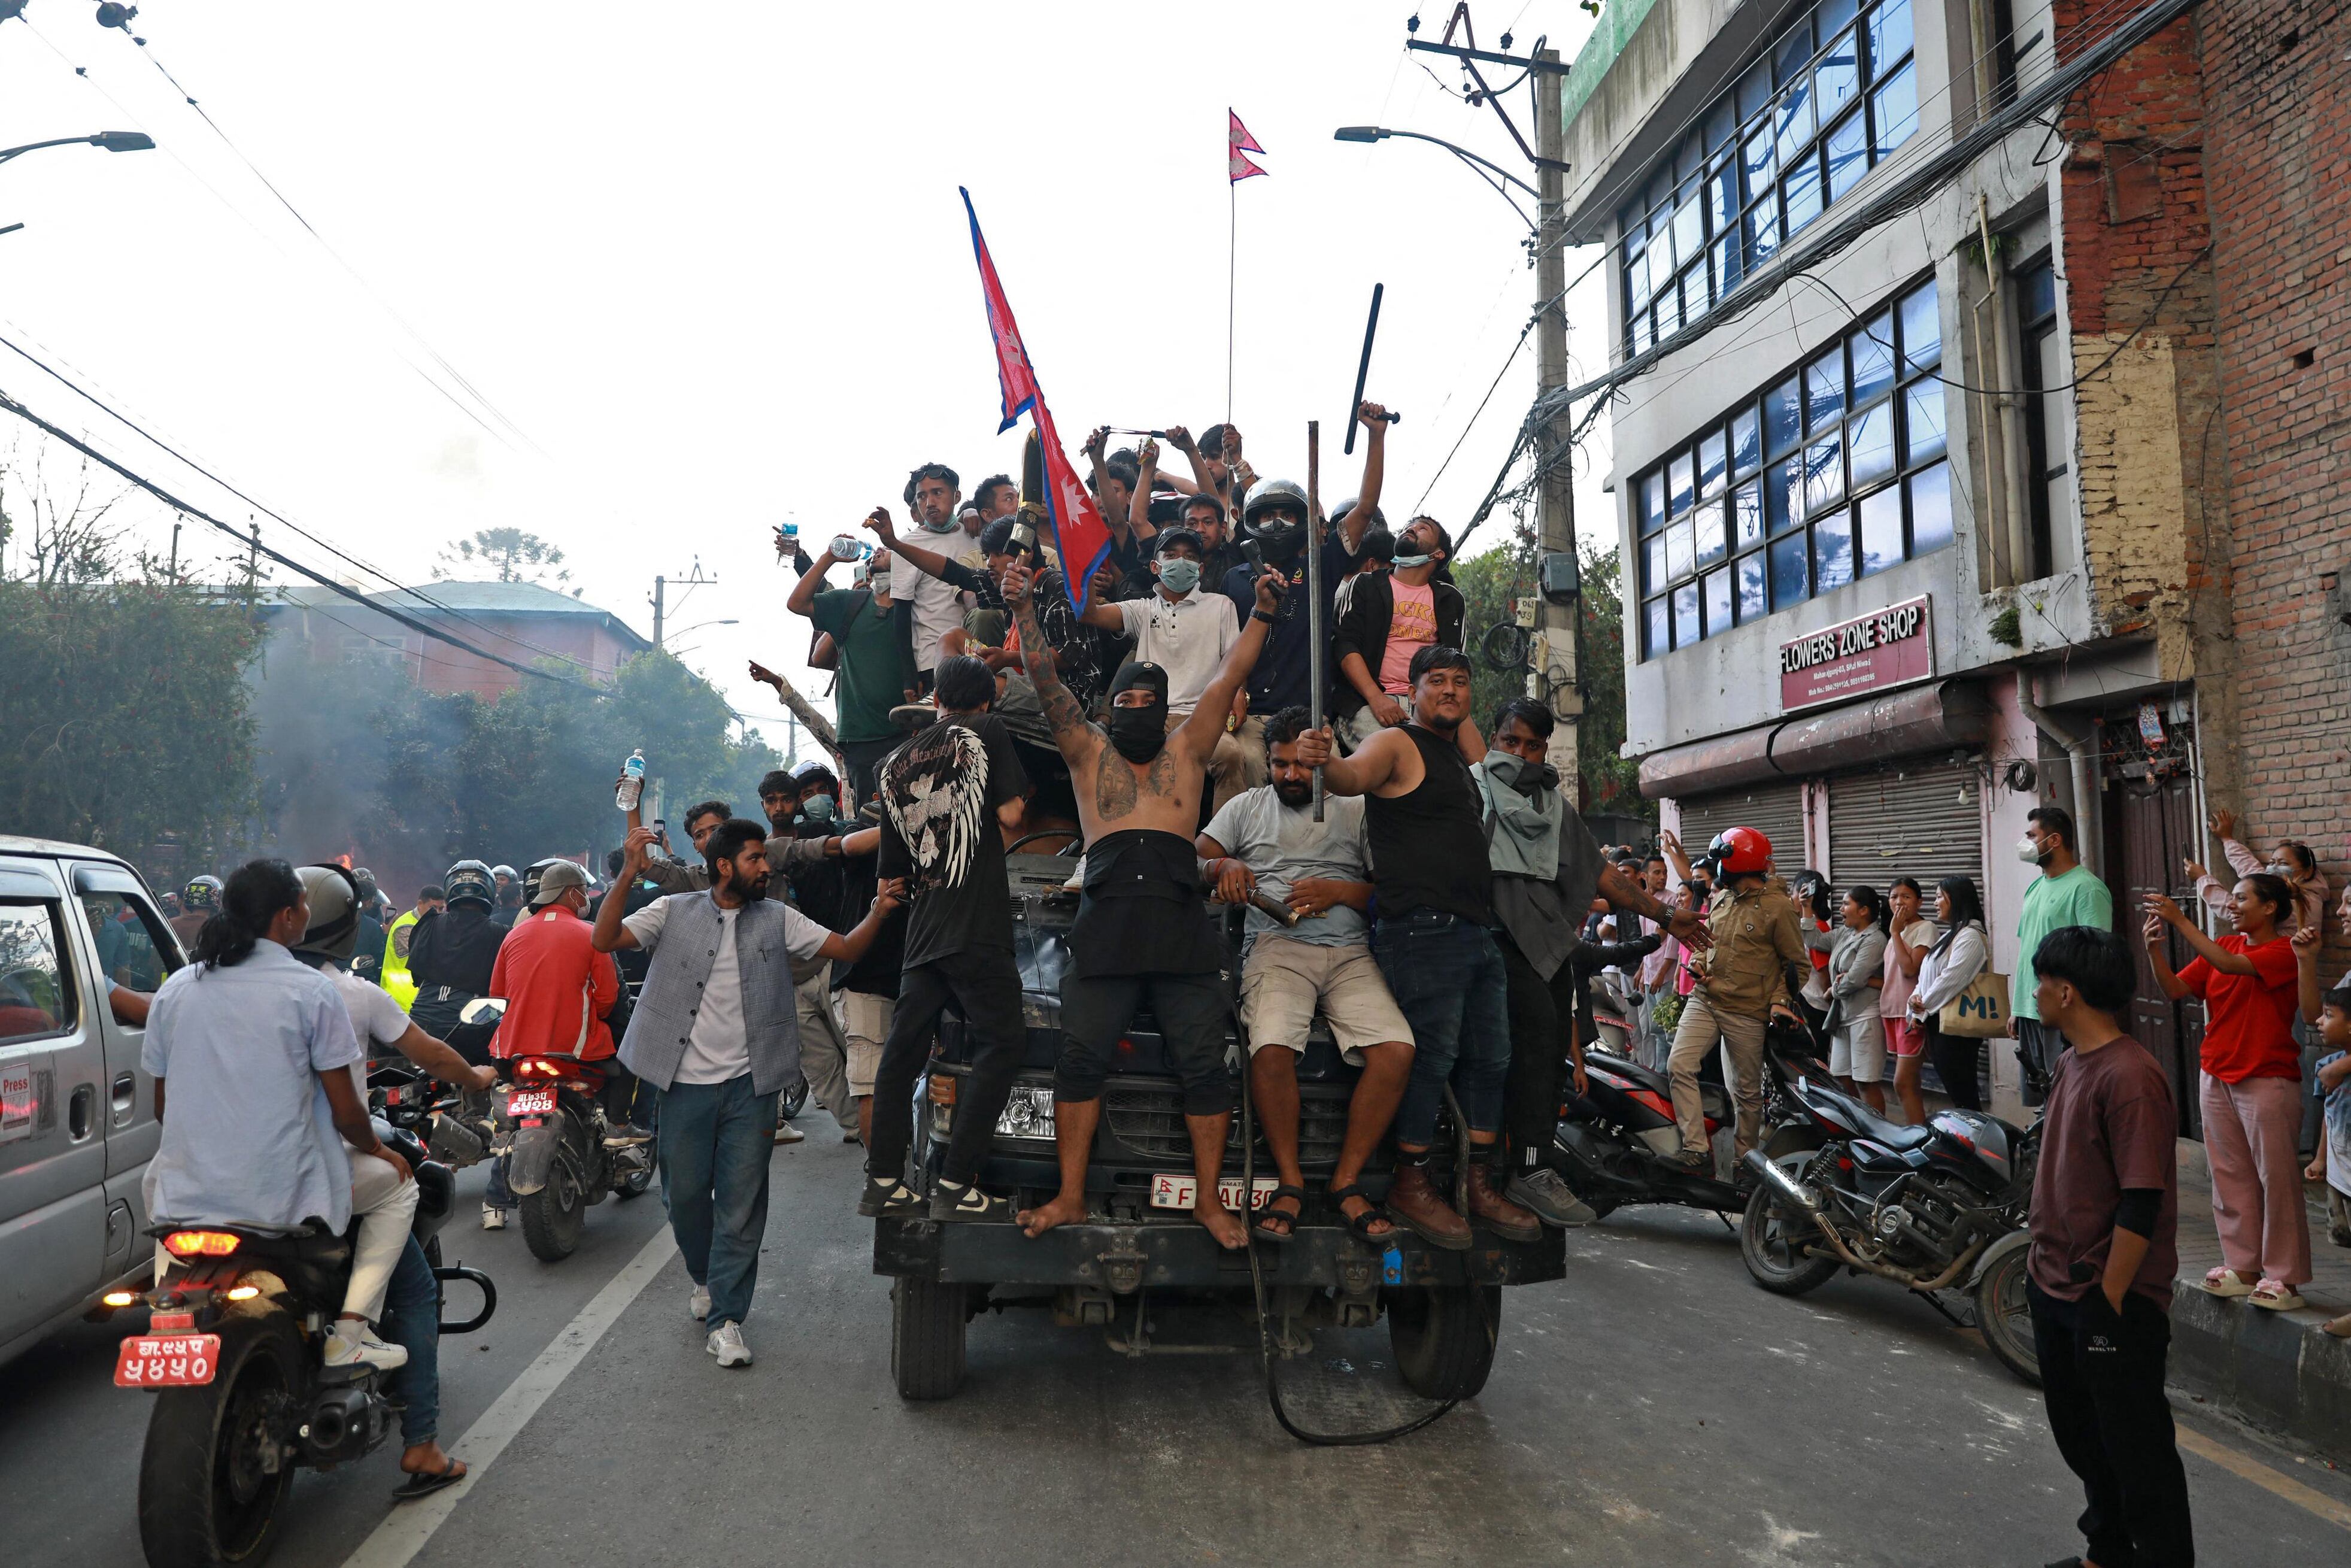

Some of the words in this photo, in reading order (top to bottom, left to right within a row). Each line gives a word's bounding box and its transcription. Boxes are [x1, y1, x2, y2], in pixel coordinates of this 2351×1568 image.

[1521, 611, 1532, 620] 39
[1780, 633, 1835, 674] FLOWERS
[1840, 620, 1875, 656] ZONE
[1879, 606, 1918, 644] SHOP
[1958, 994, 1999, 1019] M!
[3, 1078, 28, 1094] Press
[1178, 1188, 1193, 1205] F
[125, 1357, 207, 1382] ५४५०
